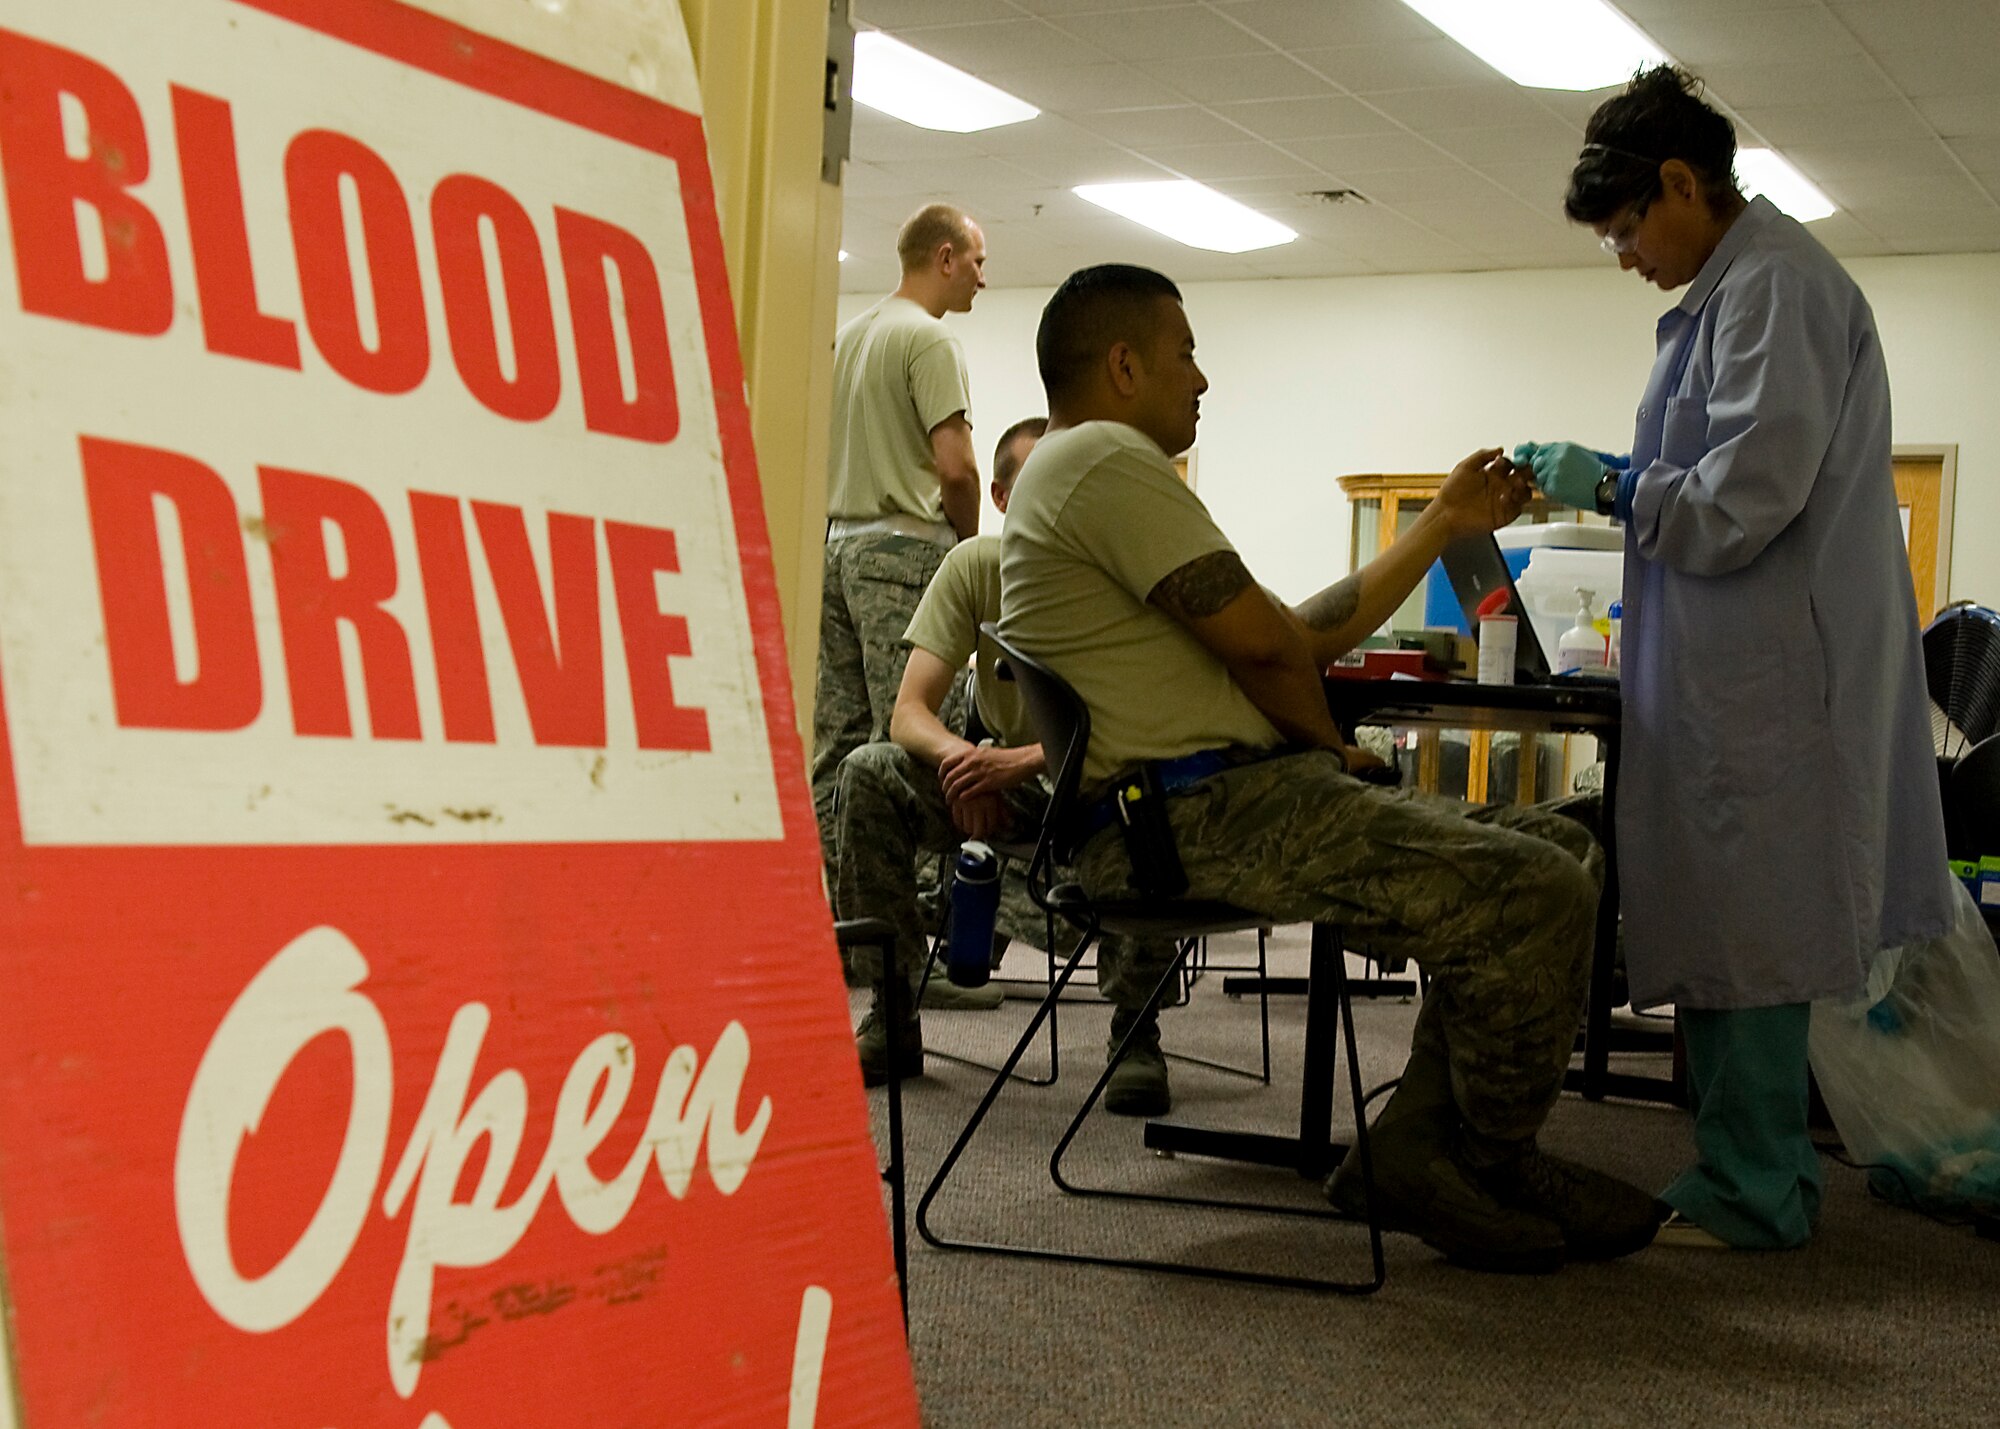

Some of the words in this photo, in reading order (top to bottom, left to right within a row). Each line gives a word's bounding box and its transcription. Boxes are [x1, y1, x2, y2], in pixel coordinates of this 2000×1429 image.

[0, 29, 679, 443] BLOOD
[78, 435, 711, 752] DRIVE
[175, 926, 772, 1398] Open
